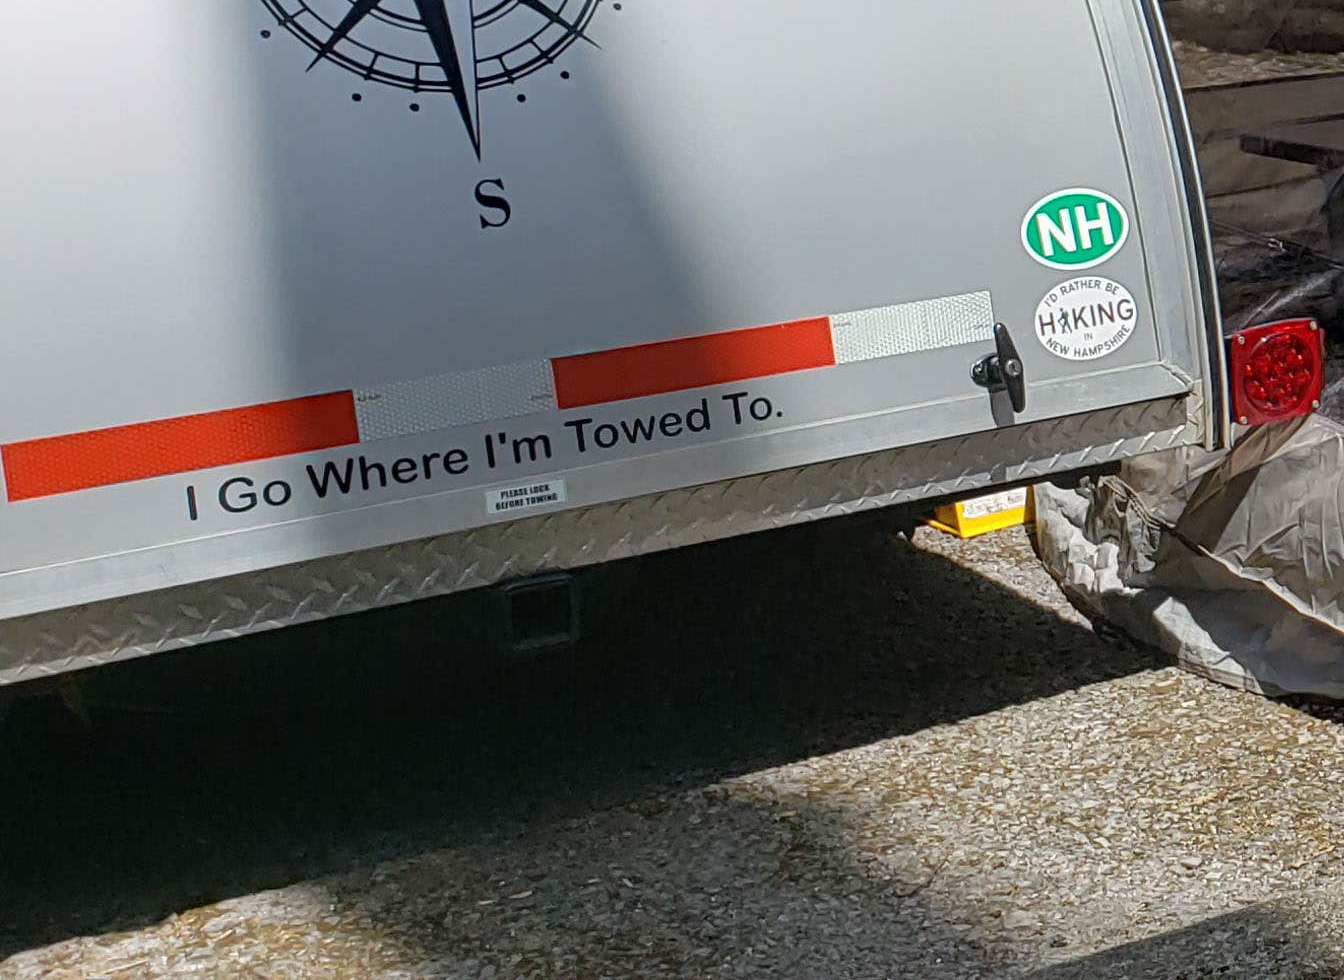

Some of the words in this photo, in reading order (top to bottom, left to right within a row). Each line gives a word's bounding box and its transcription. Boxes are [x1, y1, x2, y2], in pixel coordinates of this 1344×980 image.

[474, 178, 512, 229] S
[1036, 202, 1114, 257] NH
[1044, 292, 1058, 308] I'D
[1060, 279, 1101, 296] RATHER
[1105, 282, 1119, 296] BE
[1047, 337, 1070, 355] NEW
[1074, 324, 1130, 358] HAMPSHIRE
[1084, 332, 1093, 341] IN
[186, 486, 198, 521] I
[218, 477, 292, 514] Go
[306, 448, 469, 500] Where
[486, 432, 552, 469] I'm
[565, 401, 711, 454] Towed
[722, 391, 784, 427] To.
[495, 499, 524, 510] BEFORE
[526, 493, 557, 505] TOWING
[501, 488, 528, 499] PLEASE
[530, 484, 550, 494] LOCK
